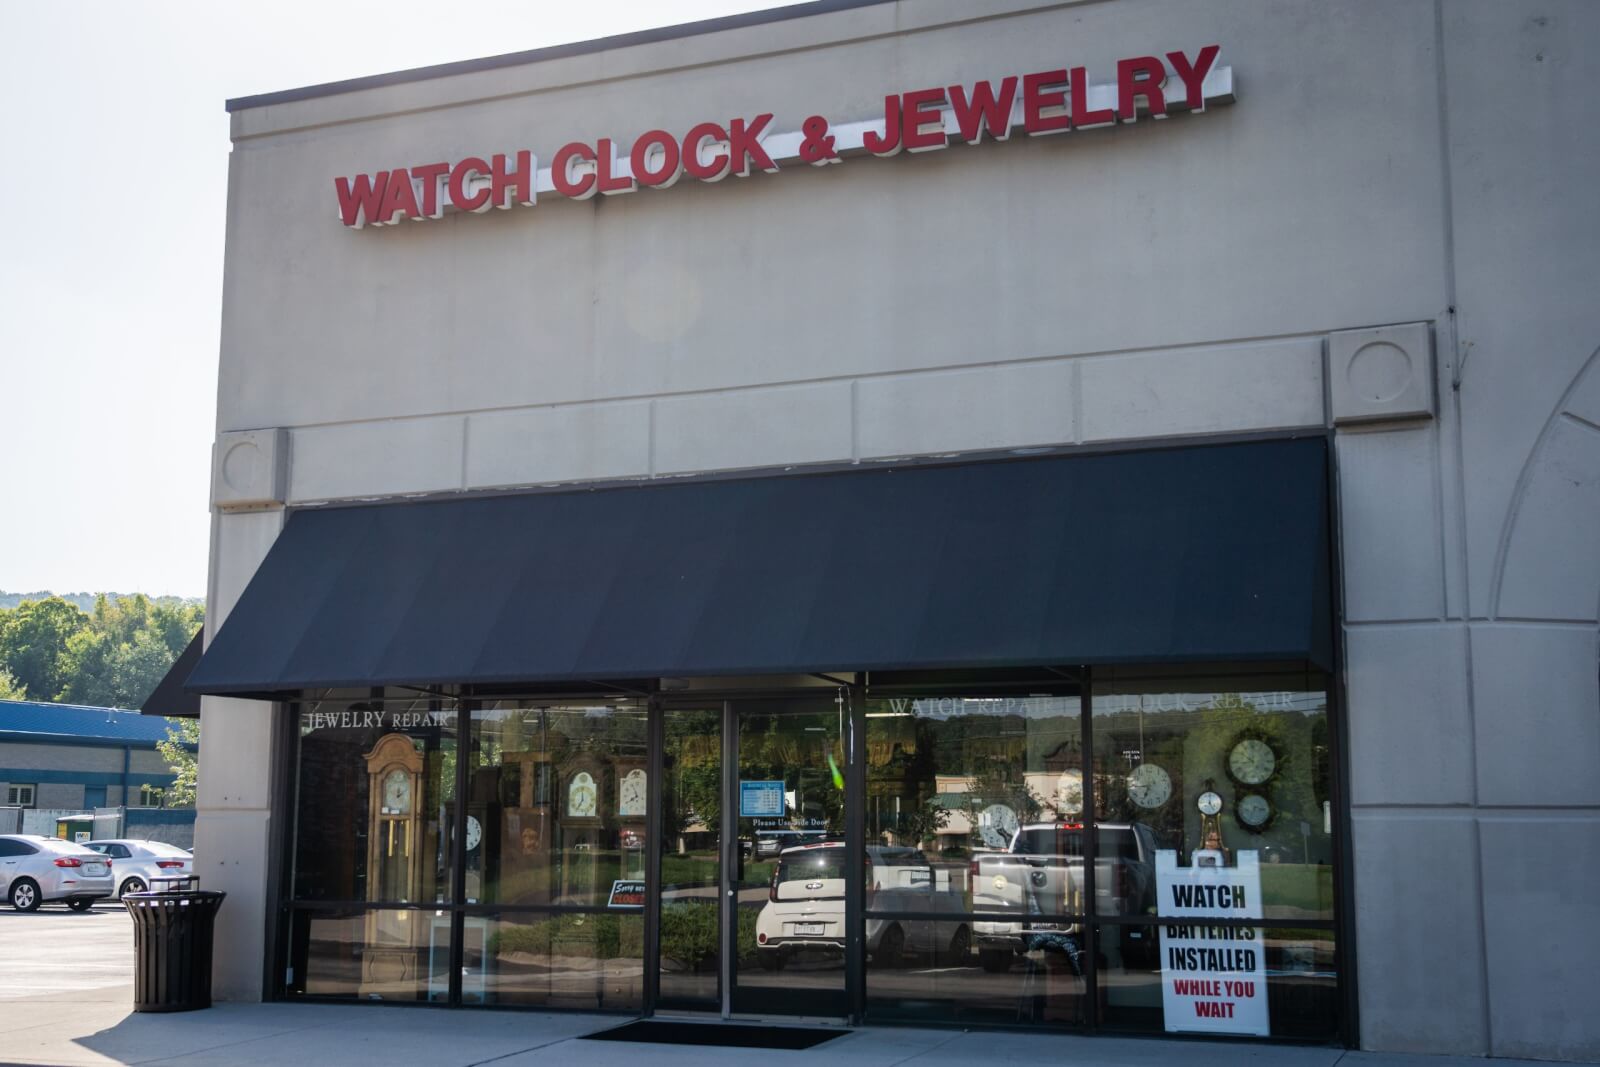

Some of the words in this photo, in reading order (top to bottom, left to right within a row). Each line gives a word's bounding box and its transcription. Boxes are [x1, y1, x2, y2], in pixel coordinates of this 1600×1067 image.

[335, 149, 537, 229] WATCH
[551, 113, 778, 199] CLOCK
[799, 115, 840, 166] &
[863, 45, 1221, 156] JEWELRY
[888, 697, 967, 716] WATCH
[1208, 691, 1295, 709] REPAIR
[308, 711, 387, 729] JEWELRY
[392, 711, 449, 728] REPAIR
[752, 818, 776, 826] Please
[778, 818, 790, 826] Use
[811, 818, 829, 826] Door
[1171, 884, 1246, 909] WATCH
[1166, 917, 1256, 940] BATTERIES
[1168, 947, 1256, 973] INSTALLED
[1173, 979, 1221, 997] WHILE
[1224, 980, 1255, 998] YOU
[1194, 1001, 1235, 1018] WAIT
